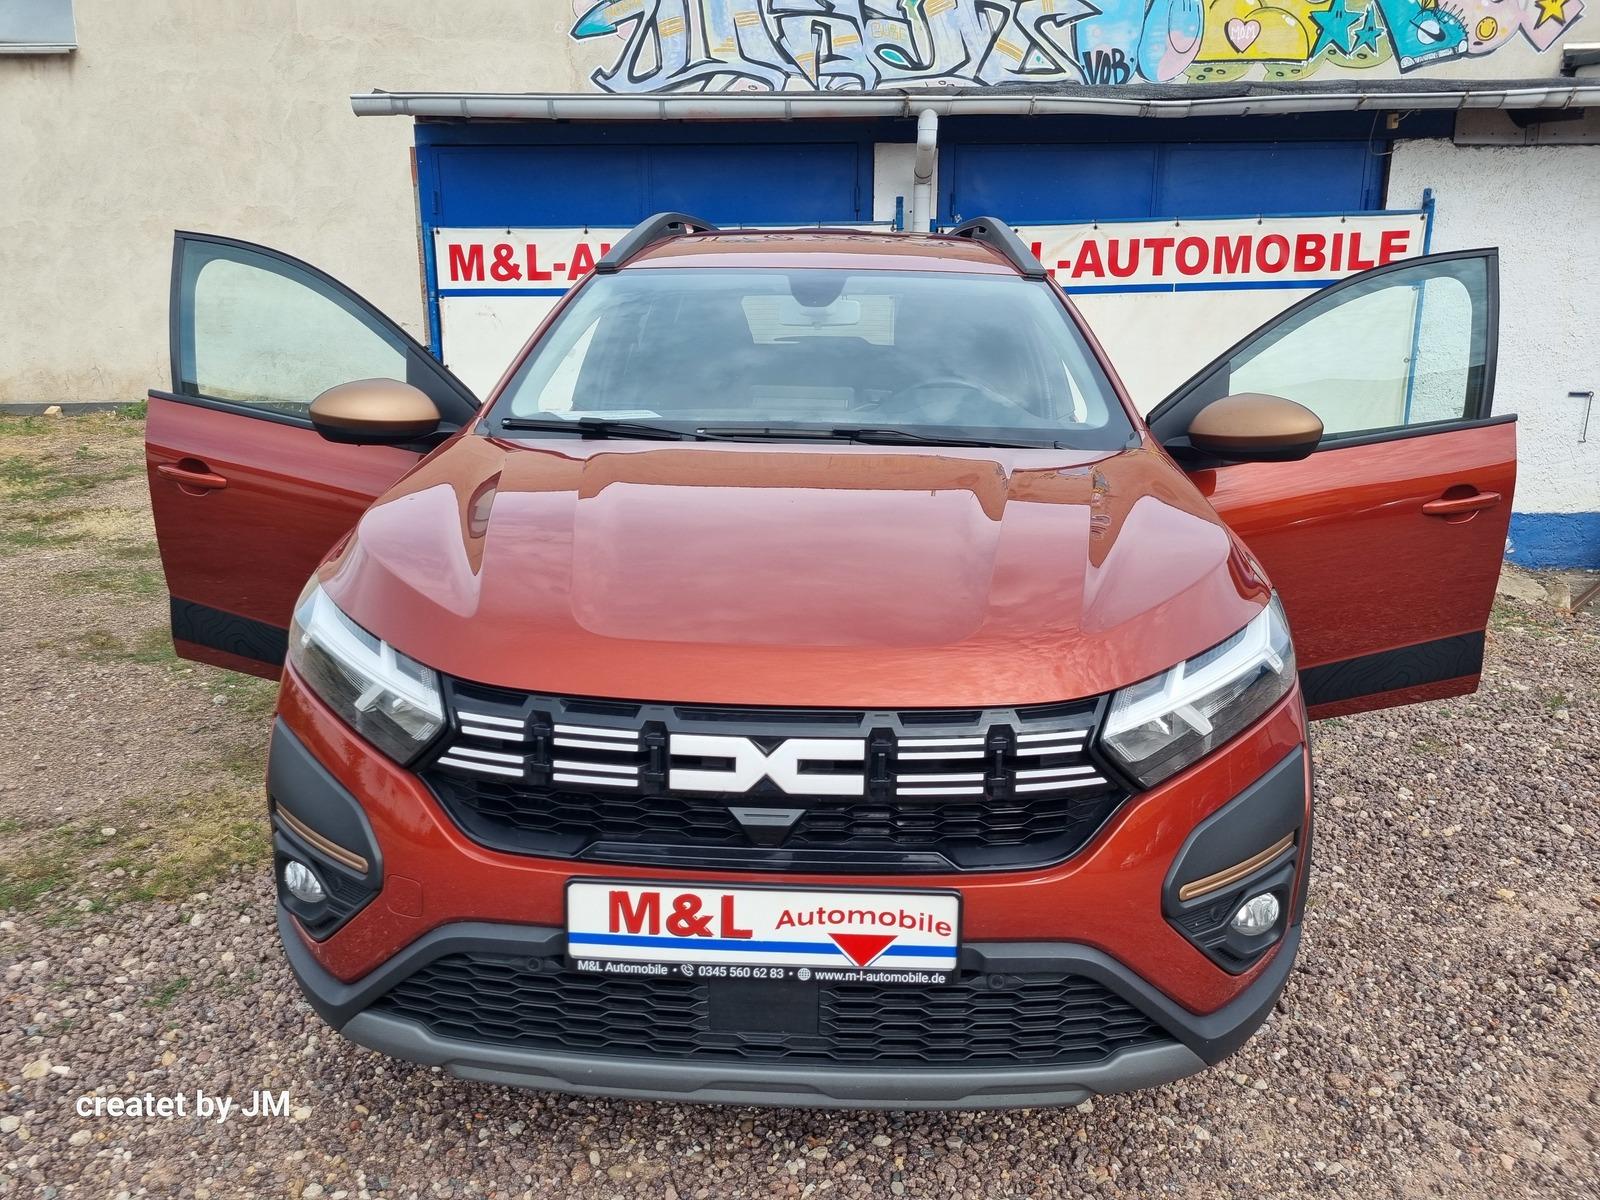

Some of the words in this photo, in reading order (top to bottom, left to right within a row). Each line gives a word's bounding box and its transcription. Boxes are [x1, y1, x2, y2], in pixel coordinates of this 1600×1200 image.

[448, 243, 611, 281] M&L-A
[609, 891, 753, 939] M&L
[775, 907, 952, 937] Automobile
[577, 960, 603, 972] M&L
[605, 962, 668, 975] Automobile
[698, 966, 727, 977] 0345
[729, 967, 750, 978] 560
[753, 967, 767, 978] 62
[769, 968, 784, 979] 83
[815, 971, 946, 984] www.m-l-automobile.de
